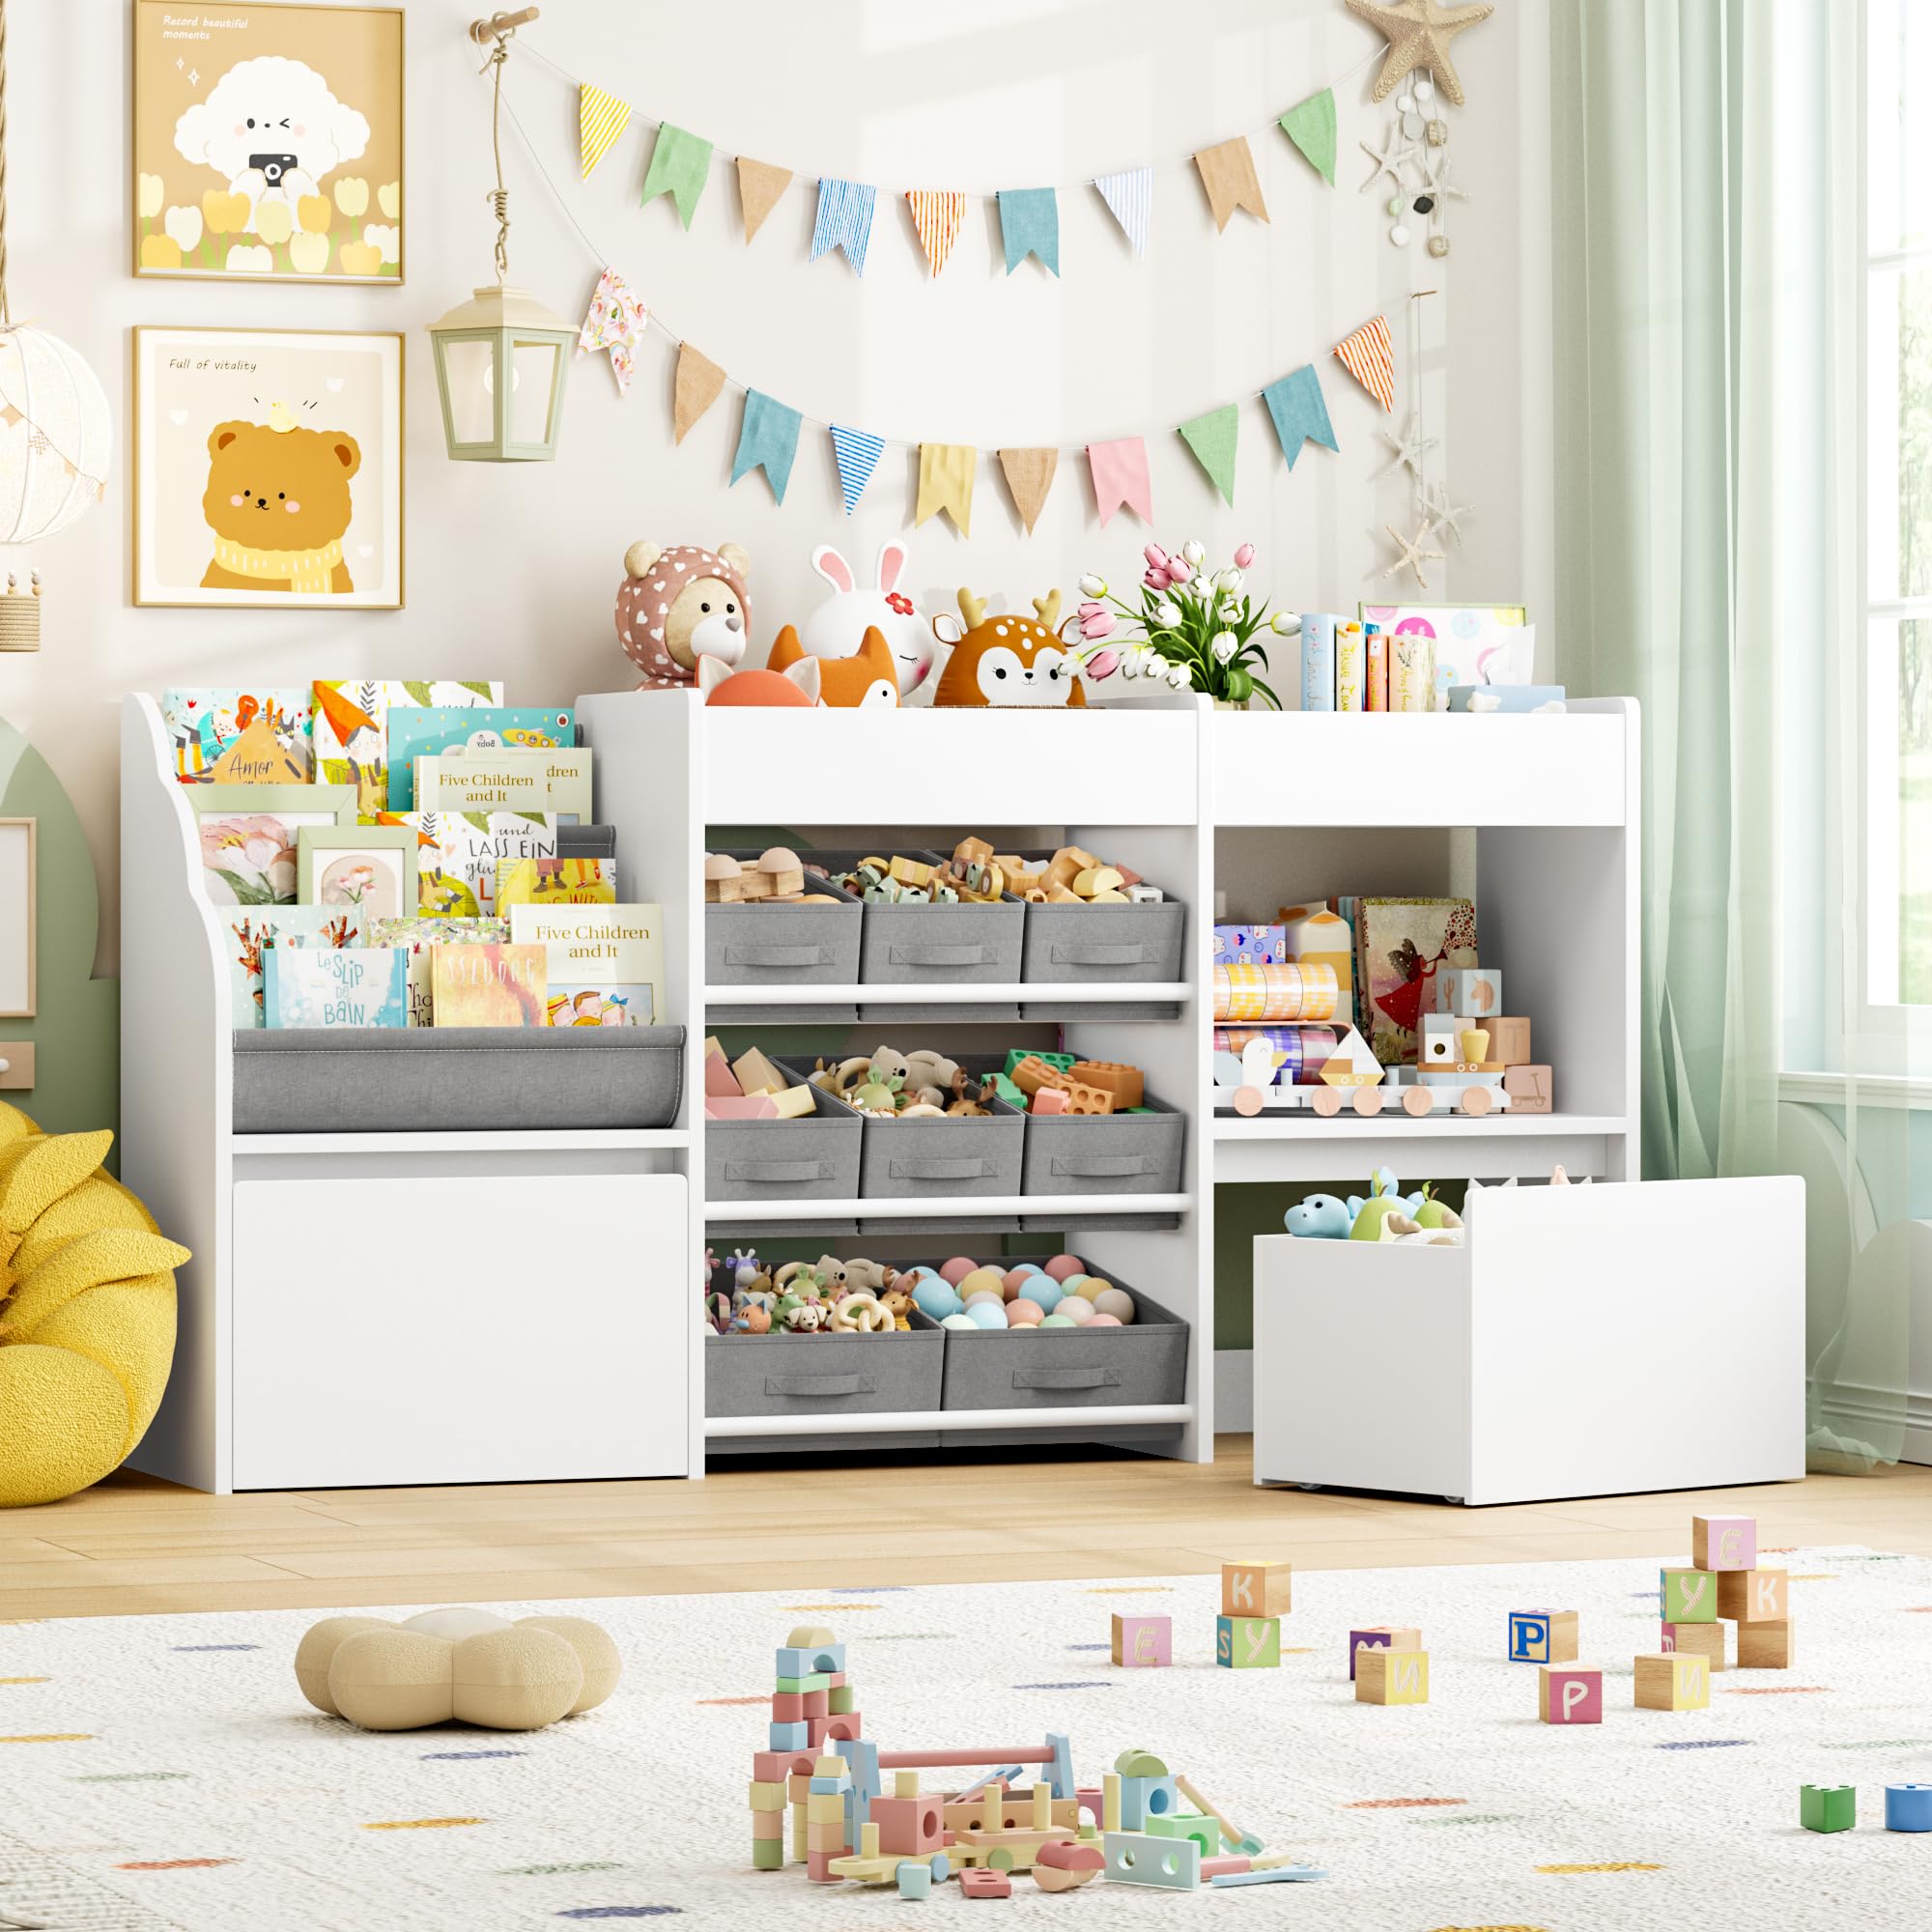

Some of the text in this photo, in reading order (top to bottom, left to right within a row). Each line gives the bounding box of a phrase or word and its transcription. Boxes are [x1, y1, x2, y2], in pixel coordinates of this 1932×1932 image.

[162, 15, 248, 29] Record beautiful
[162, 30, 210, 40] moments
[169, 358, 257, 373] Full of vitality
[229, 753, 273, 780] Amor
[440, 774, 534, 786] Five Children
[466, 789, 507, 802] and It
[496, 823, 533, 836] und
[469, 838, 508, 859] LASS
[536, 924, 650, 940] Five Children
[317, 951, 331, 971] Le
[569, 944, 619, 958] and It
[1719, 1529, 1743, 1567] E
[1232, 1572, 1255, 1608] K
[1756, 1577, 1778, 1615] K
[1133, 1625, 1158, 1663] E
[1514, 1621, 1545, 1657] P
[1562, 1681, 1589, 1721] P
